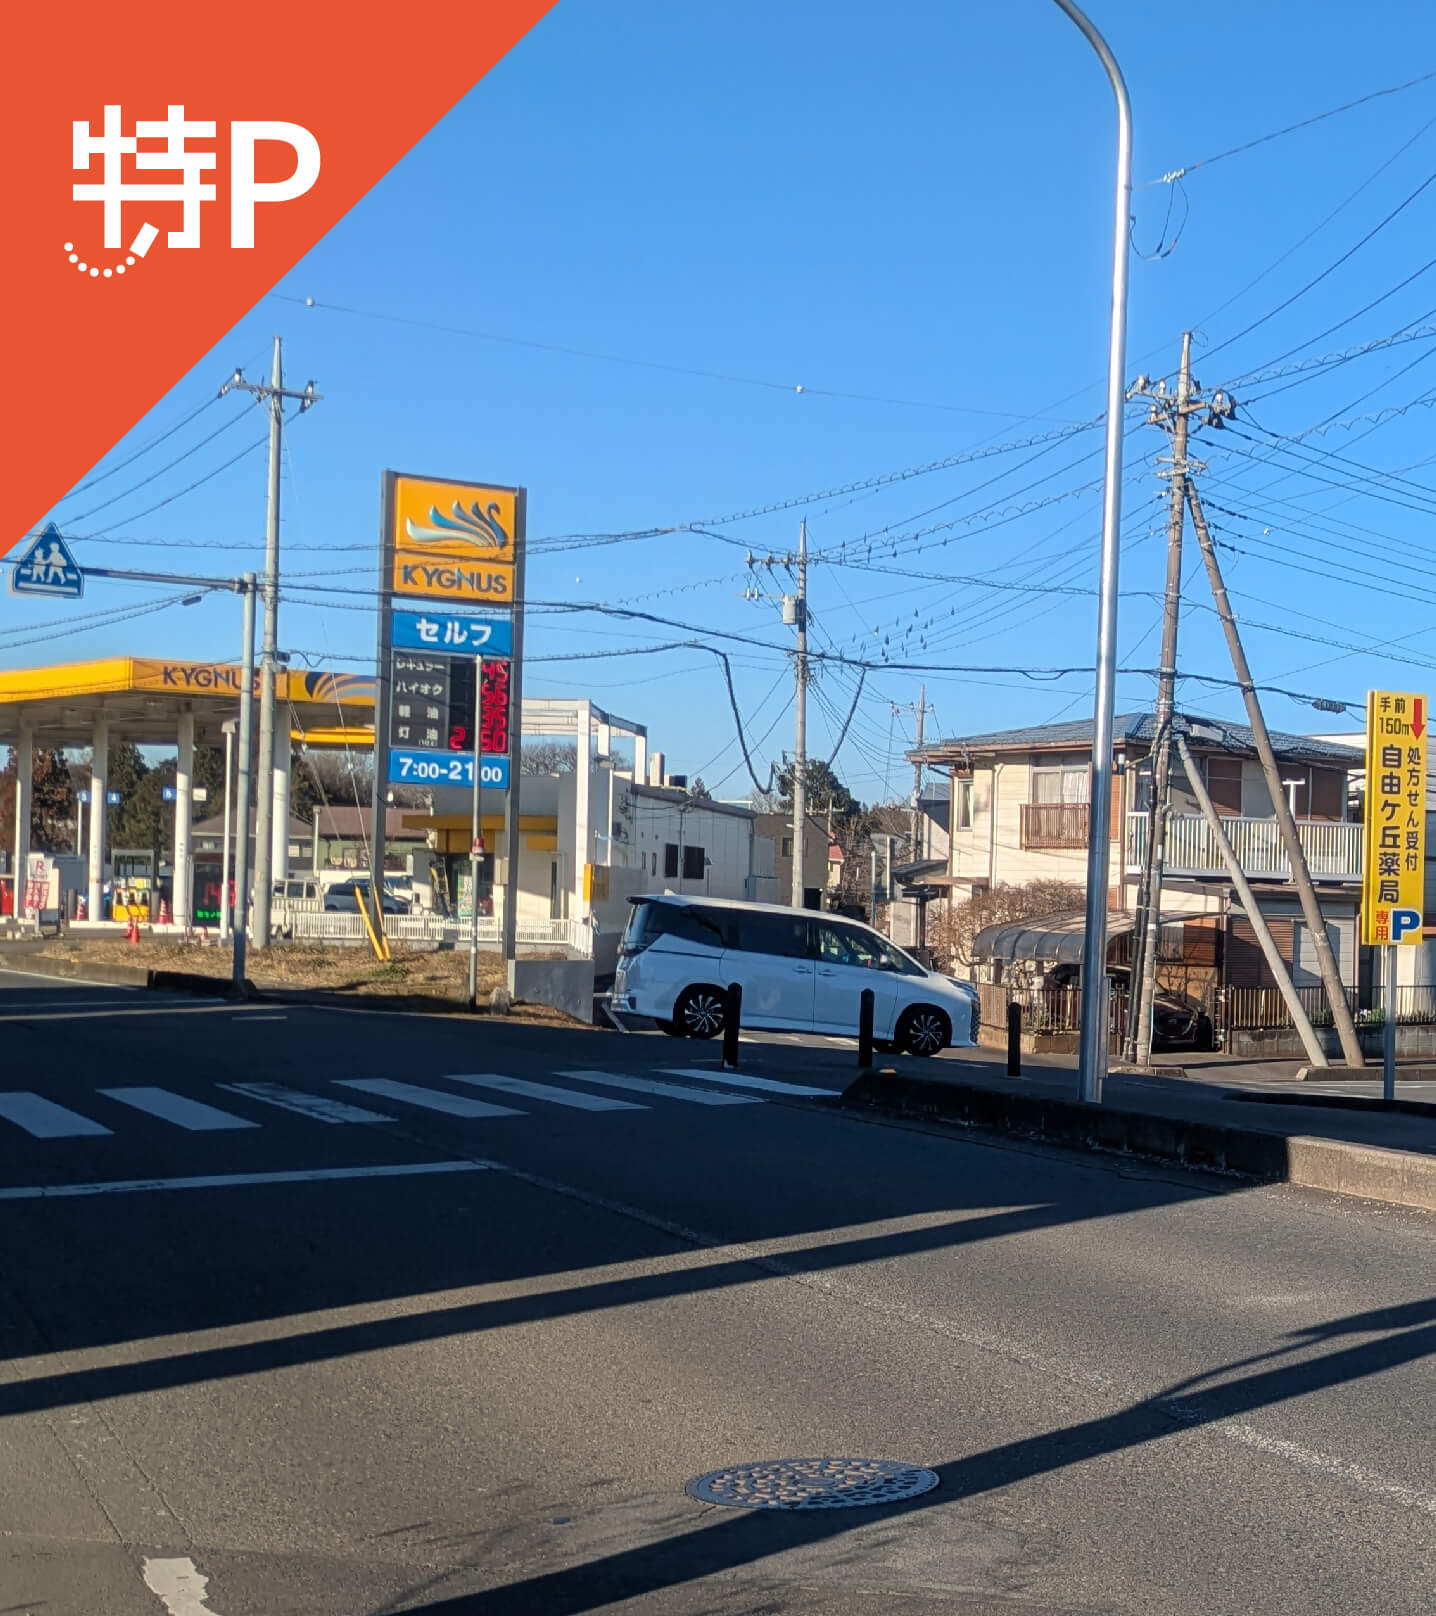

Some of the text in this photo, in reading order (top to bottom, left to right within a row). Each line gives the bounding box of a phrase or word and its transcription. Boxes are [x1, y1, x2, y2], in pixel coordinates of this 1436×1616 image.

[402, 564, 508, 595] KYGNUS
[416, 618, 492, 646] セルフ
[395, 680, 444, 696] ハイオク
[1379, 696, 1406, 714] 手前
[1379, 717, 1410, 736] 150m
[1404, 745, 1422, 872] 処方せん受付
[1375, 910, 1389, 941] 専用
[1391, 908, 1421, 942] P
